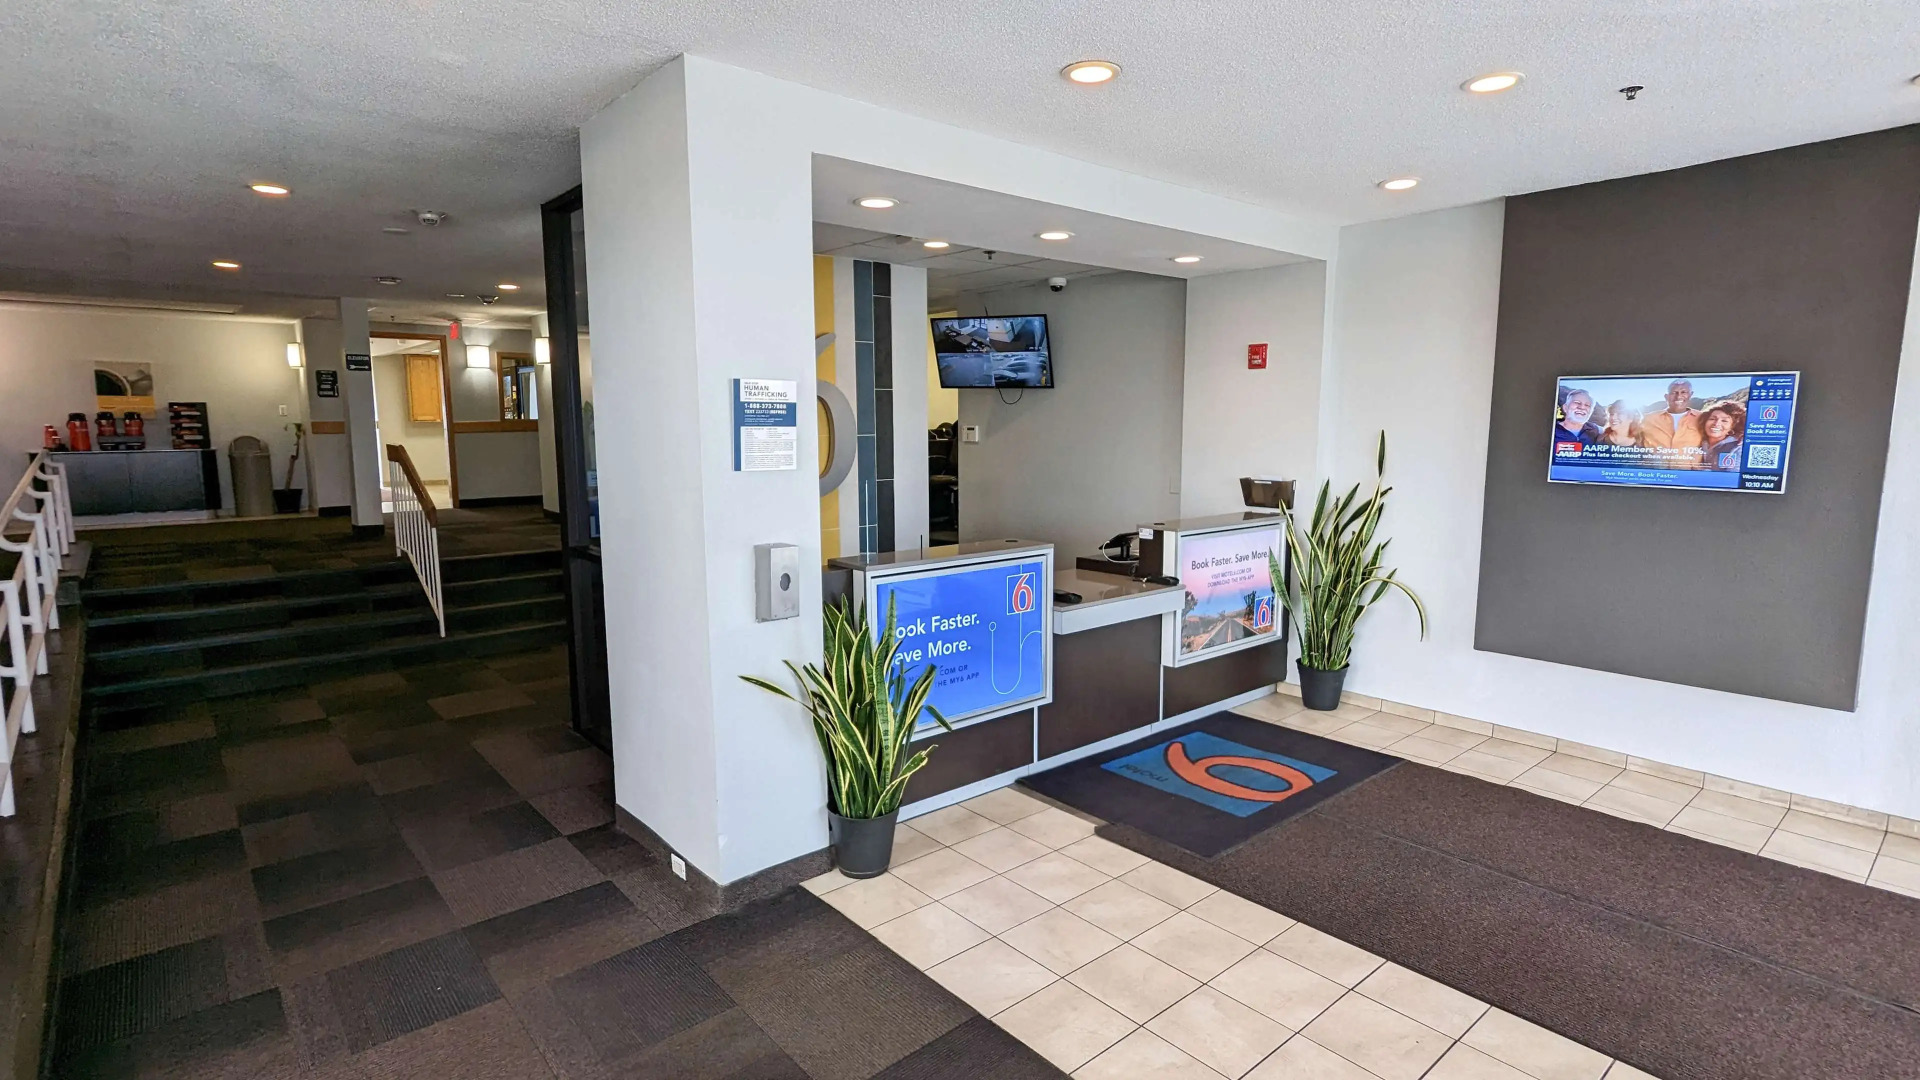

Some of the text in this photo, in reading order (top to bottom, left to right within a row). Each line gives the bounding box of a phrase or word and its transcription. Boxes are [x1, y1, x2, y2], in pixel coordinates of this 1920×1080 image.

[1611, 445, 1654, 453] Members
[1682, 446, 1707, 455] 10%.
[1192, 550, 1269, 570] Book Faster. Save More.
[1012, 573, 1033, 614] 6
[1208, 579, 1230, 588] DOWNLOAD
[1257, 596, 1270, 626] 6
[893, 613, 980, 639] ook Faster.
[892, 640, 972, 666] ave More.
[966, 672, 980, 681] APP
[1164, 741, 1314, 802] 6
